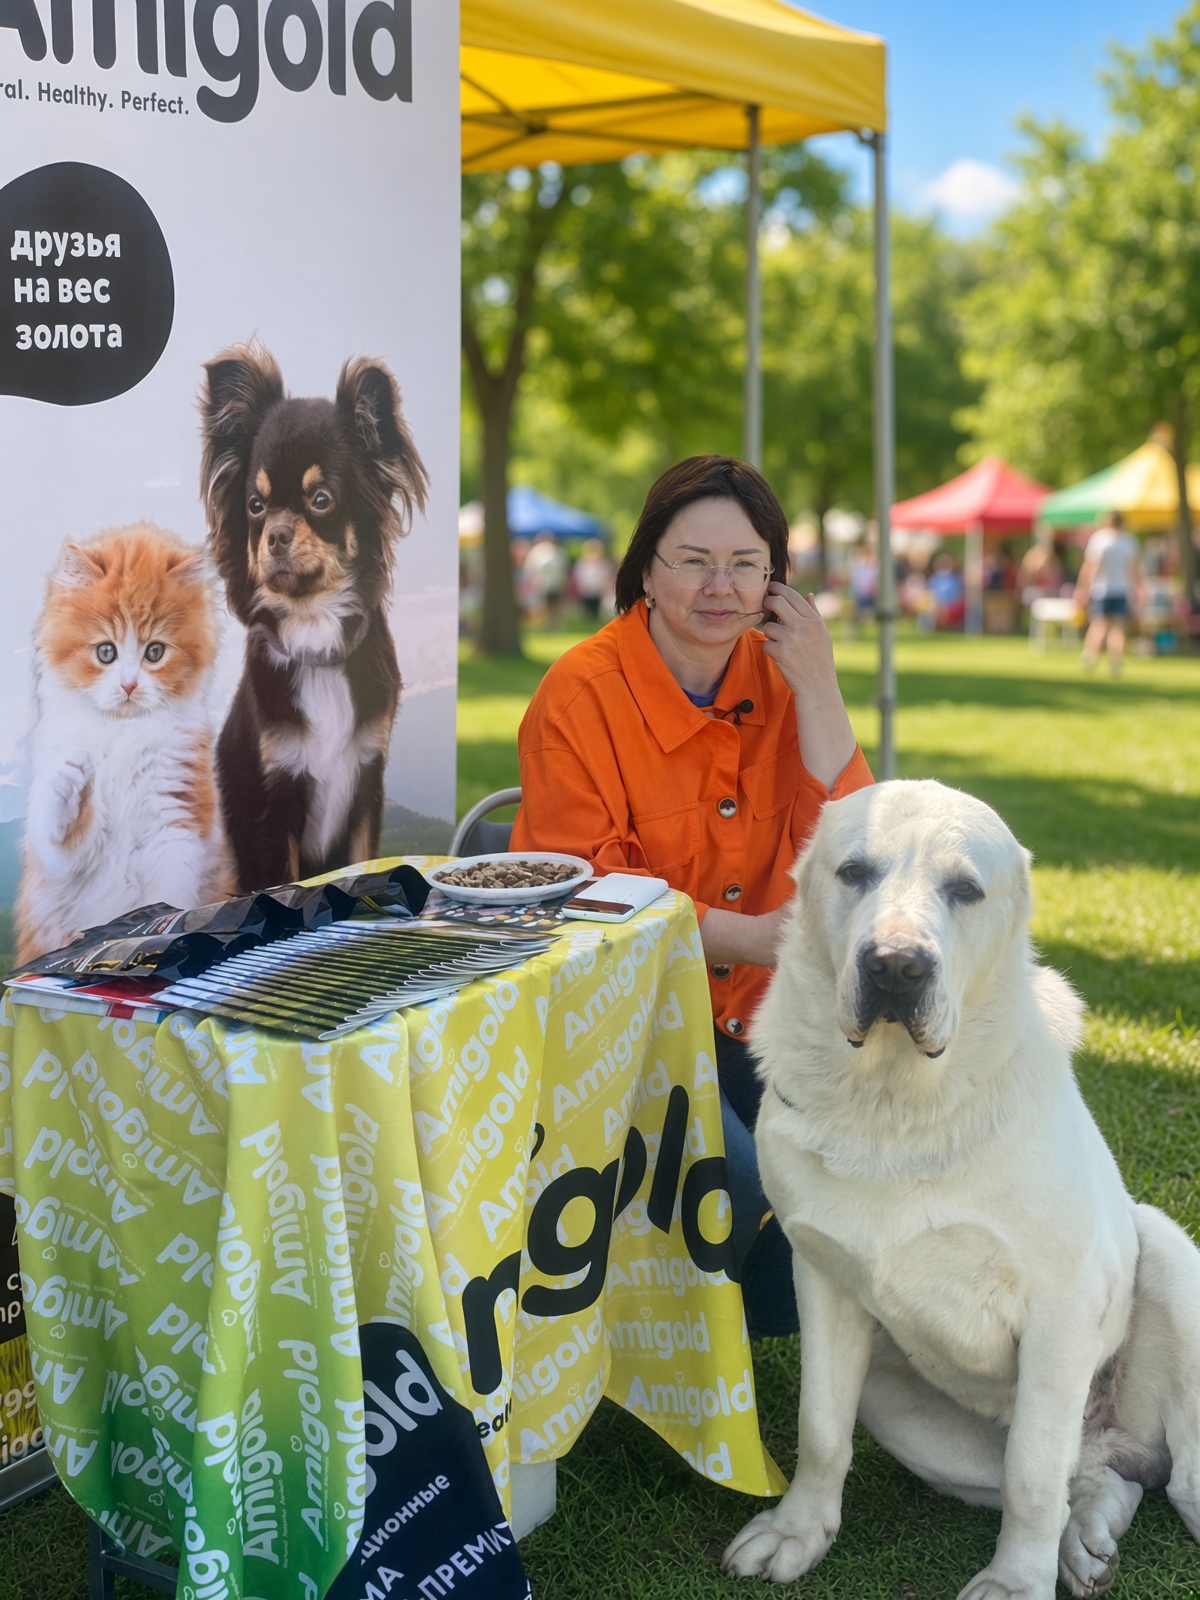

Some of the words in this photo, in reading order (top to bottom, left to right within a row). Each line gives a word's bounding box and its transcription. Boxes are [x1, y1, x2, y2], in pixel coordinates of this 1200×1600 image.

[38, 82, 114, 113] Healthy.
[121, 90, 189, 115] Perfect.
[10, 229, 121, 267] друзья
[13, 277, 50, 303] на
[58, 277, 111, 304] вес
[15, 323, 123, 350] золота
[564, 917, 668, 1051] Amigold
[71, 1049, 220, 1206] Amigold
[423, 1045, 530, 1234] Amigold
[240, 1120, 312, 1306] Amigold
[278, 1339, 331, 1548] Amigold
[625, 1368, 755, 1427] Amigold
[361, 1473, 451, 1566] ционные
